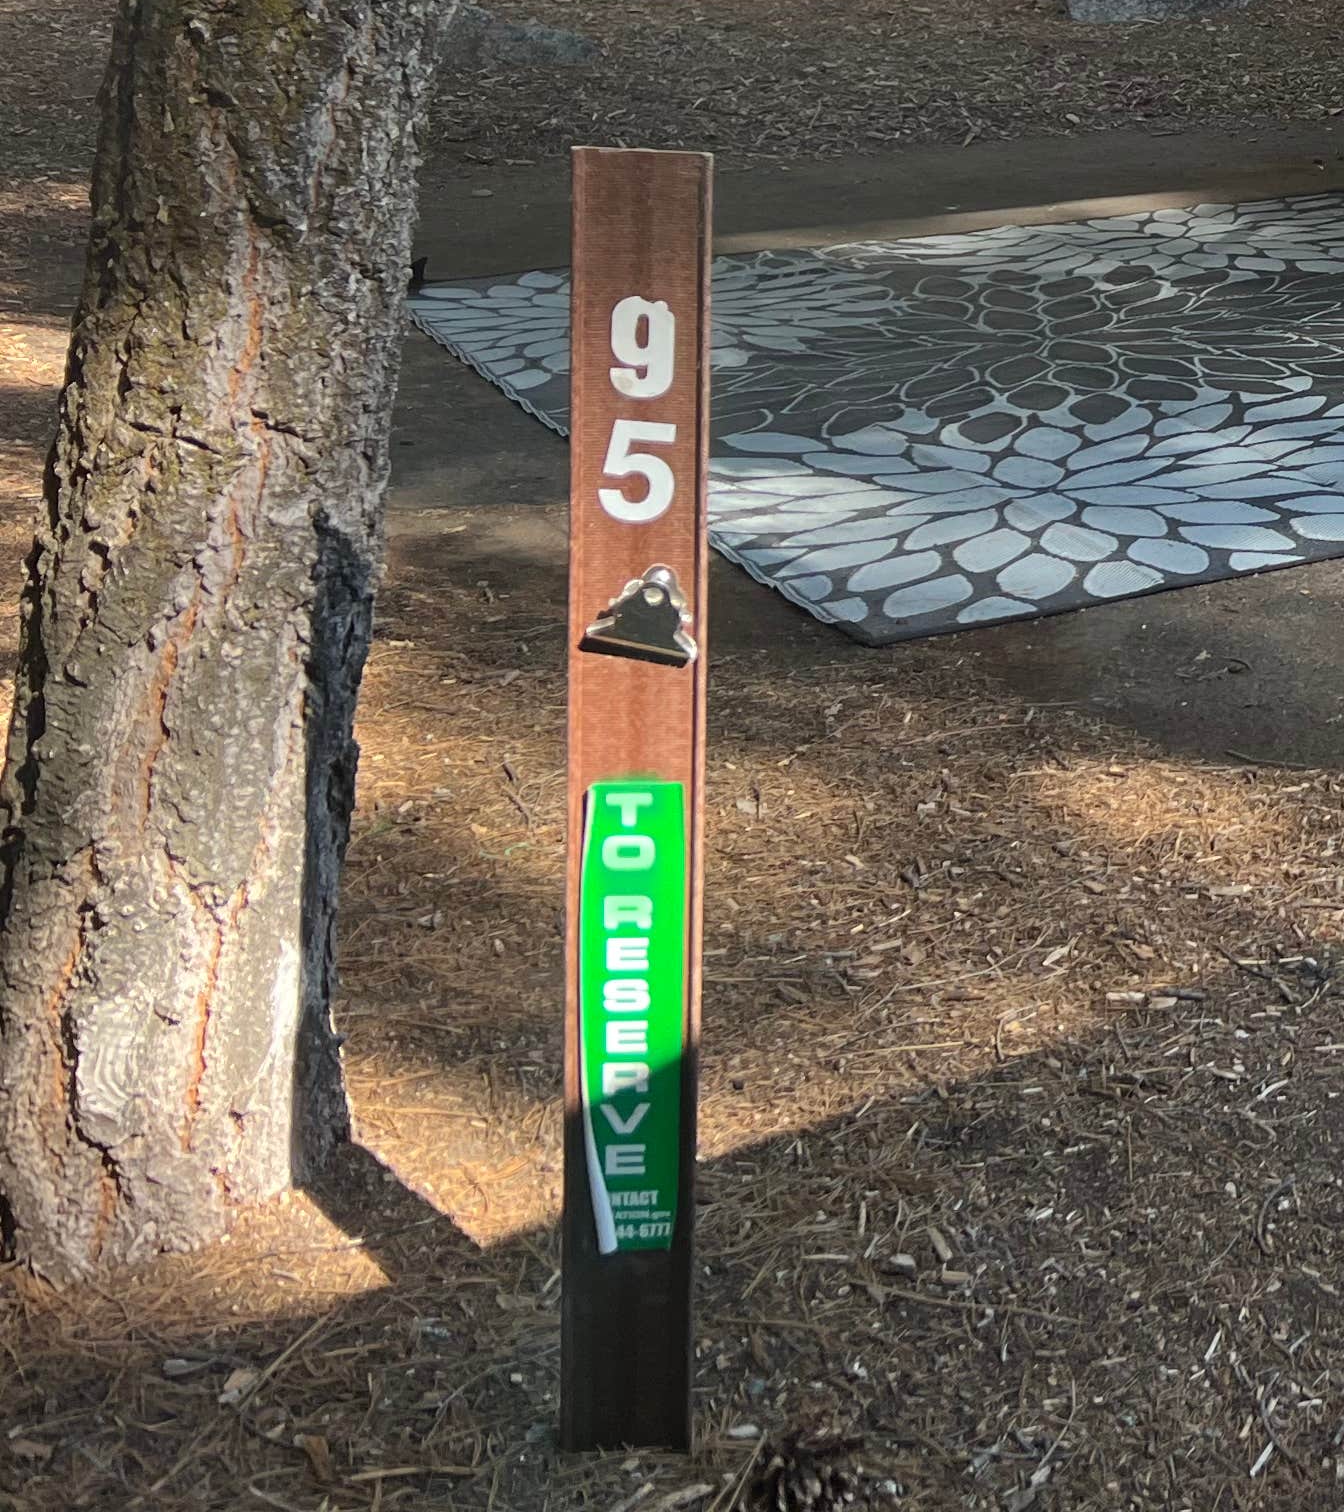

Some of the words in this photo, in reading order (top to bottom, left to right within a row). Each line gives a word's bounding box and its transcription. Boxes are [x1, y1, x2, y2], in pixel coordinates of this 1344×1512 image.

[598, 295, 678, 524] 95
[600, 791, 657, 873] TO
[600, 894, 654, 1177] RESERVE
[608, 1190, 659, 1206] NTACT
[615, 1222, 671, 1239] 44-6777
